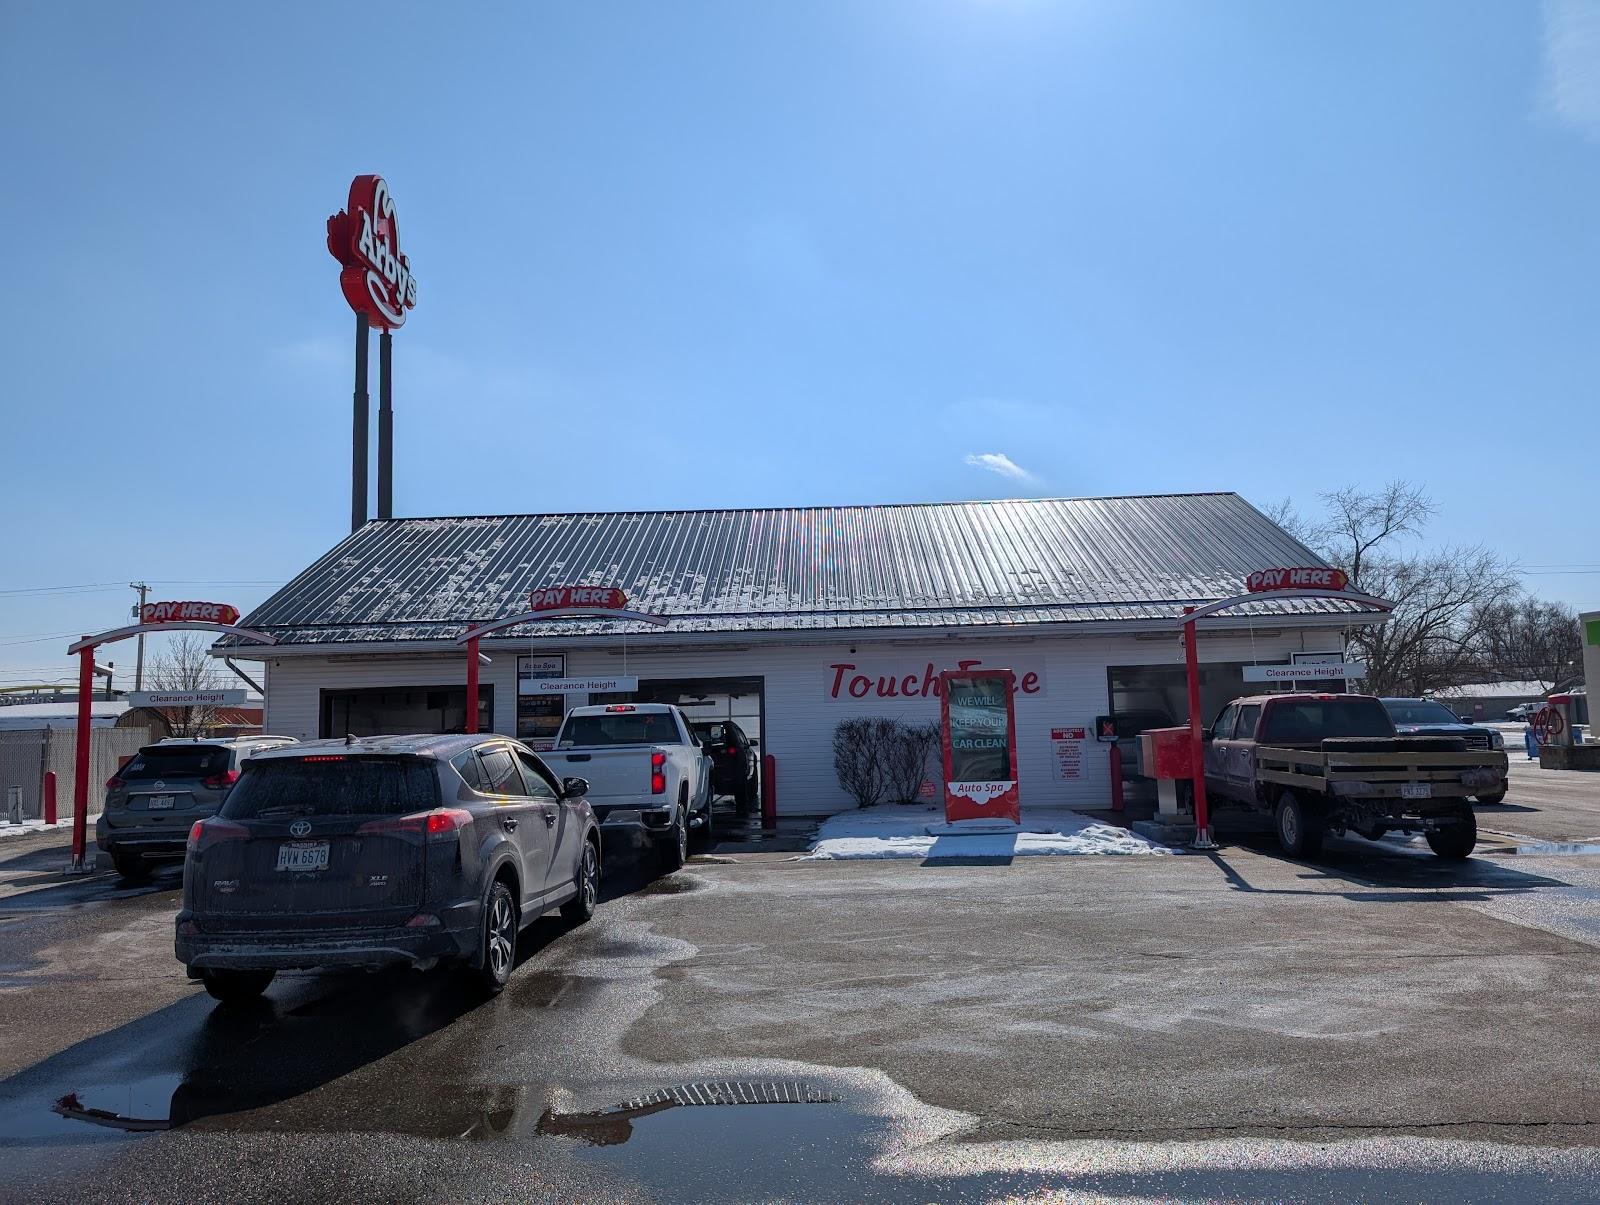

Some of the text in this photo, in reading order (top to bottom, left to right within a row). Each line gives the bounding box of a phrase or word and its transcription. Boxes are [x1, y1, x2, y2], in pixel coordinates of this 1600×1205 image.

[360, 209, 416, 307] Arby's
[1251, 569, 1333, 588] PAY HERE
[531, 588, 612, 606] PAY HERE
[143, 603, 223, 619] PAY HERE
[1266, 668, 1344, 677] Clearance Height
[540, 681, 616, 690] Clearance Height
[830, 663, 941, 698] Touch
[149, 694, 224, 703] Clearance Height
[958, 697, 996, 705] WE WILL
[953, 717, 1006, 728] KEEP YOUR
[952, 739, 1007, 748] CAR CLEAN
[958, 783, 1004, 794] Auto Spa
[301, 849, 327, 864] 6678
